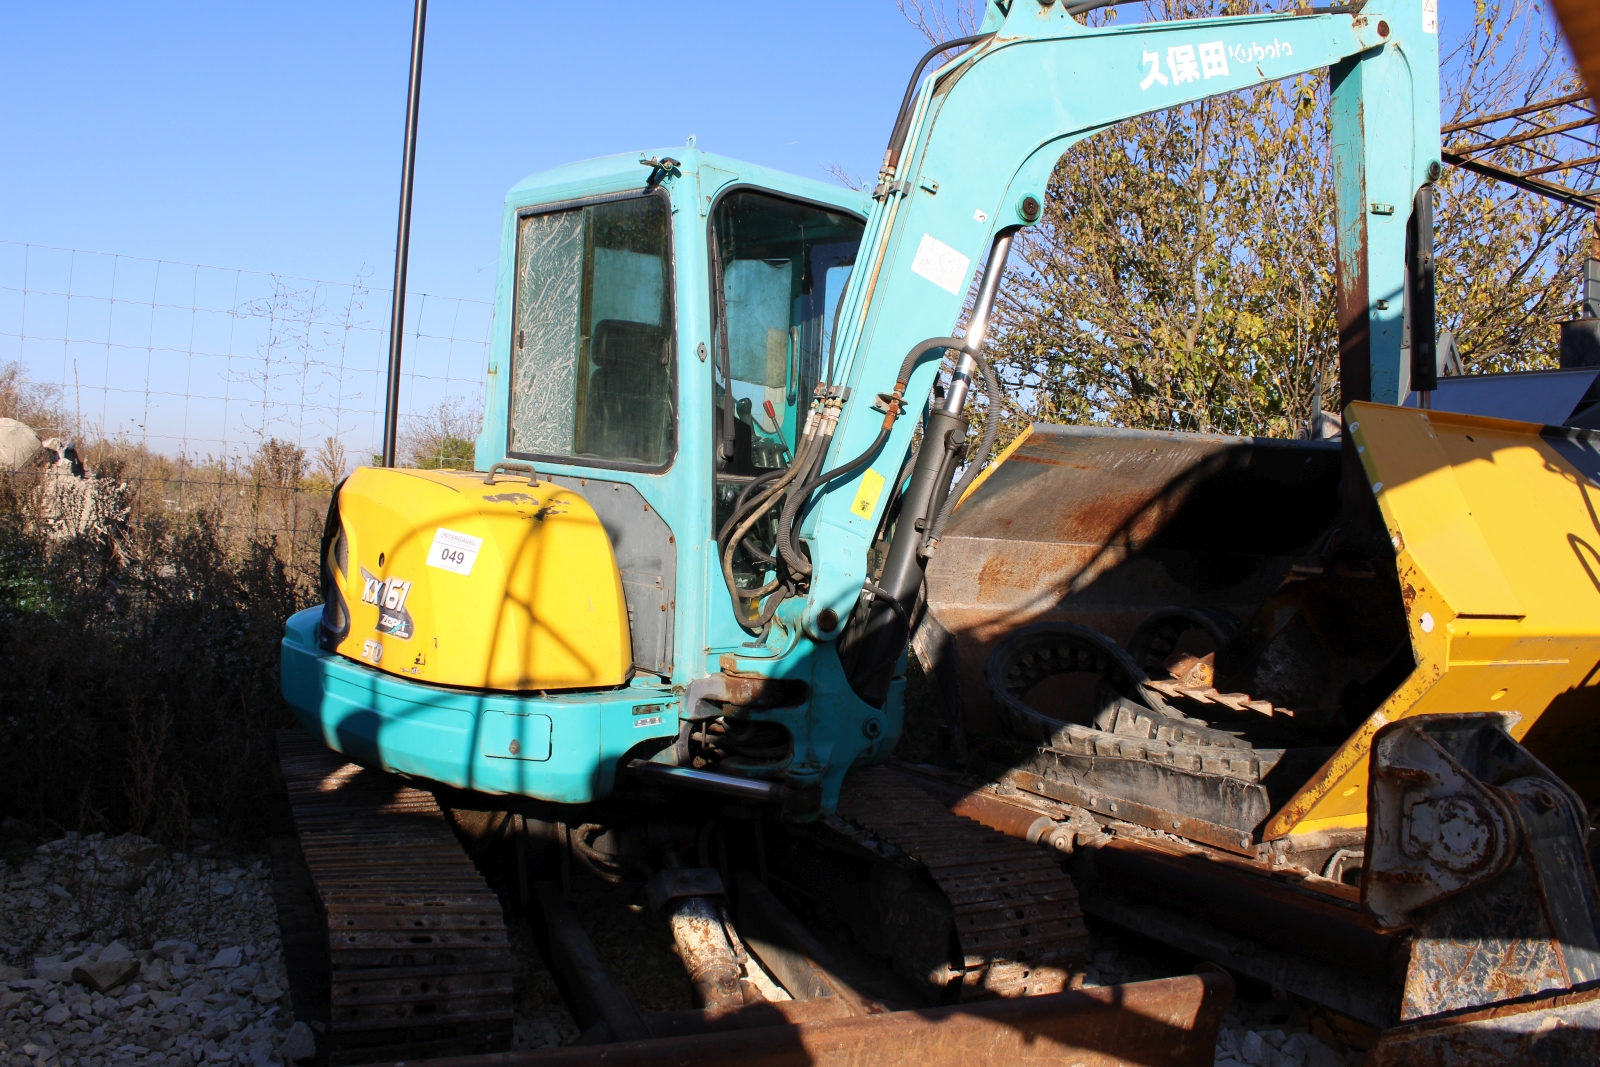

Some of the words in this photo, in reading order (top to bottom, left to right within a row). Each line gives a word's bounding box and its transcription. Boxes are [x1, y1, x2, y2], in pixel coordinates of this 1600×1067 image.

[1228, 38, 1293, 64] Kubota
[1138, 40, 1230, 91] 久保田
[441, 532, 476, 547] INTERGAVEL
[441, 548, 465, 565] 049
[361, 577, 411, 613] KX161
[361, 640, 383, 664] STD
